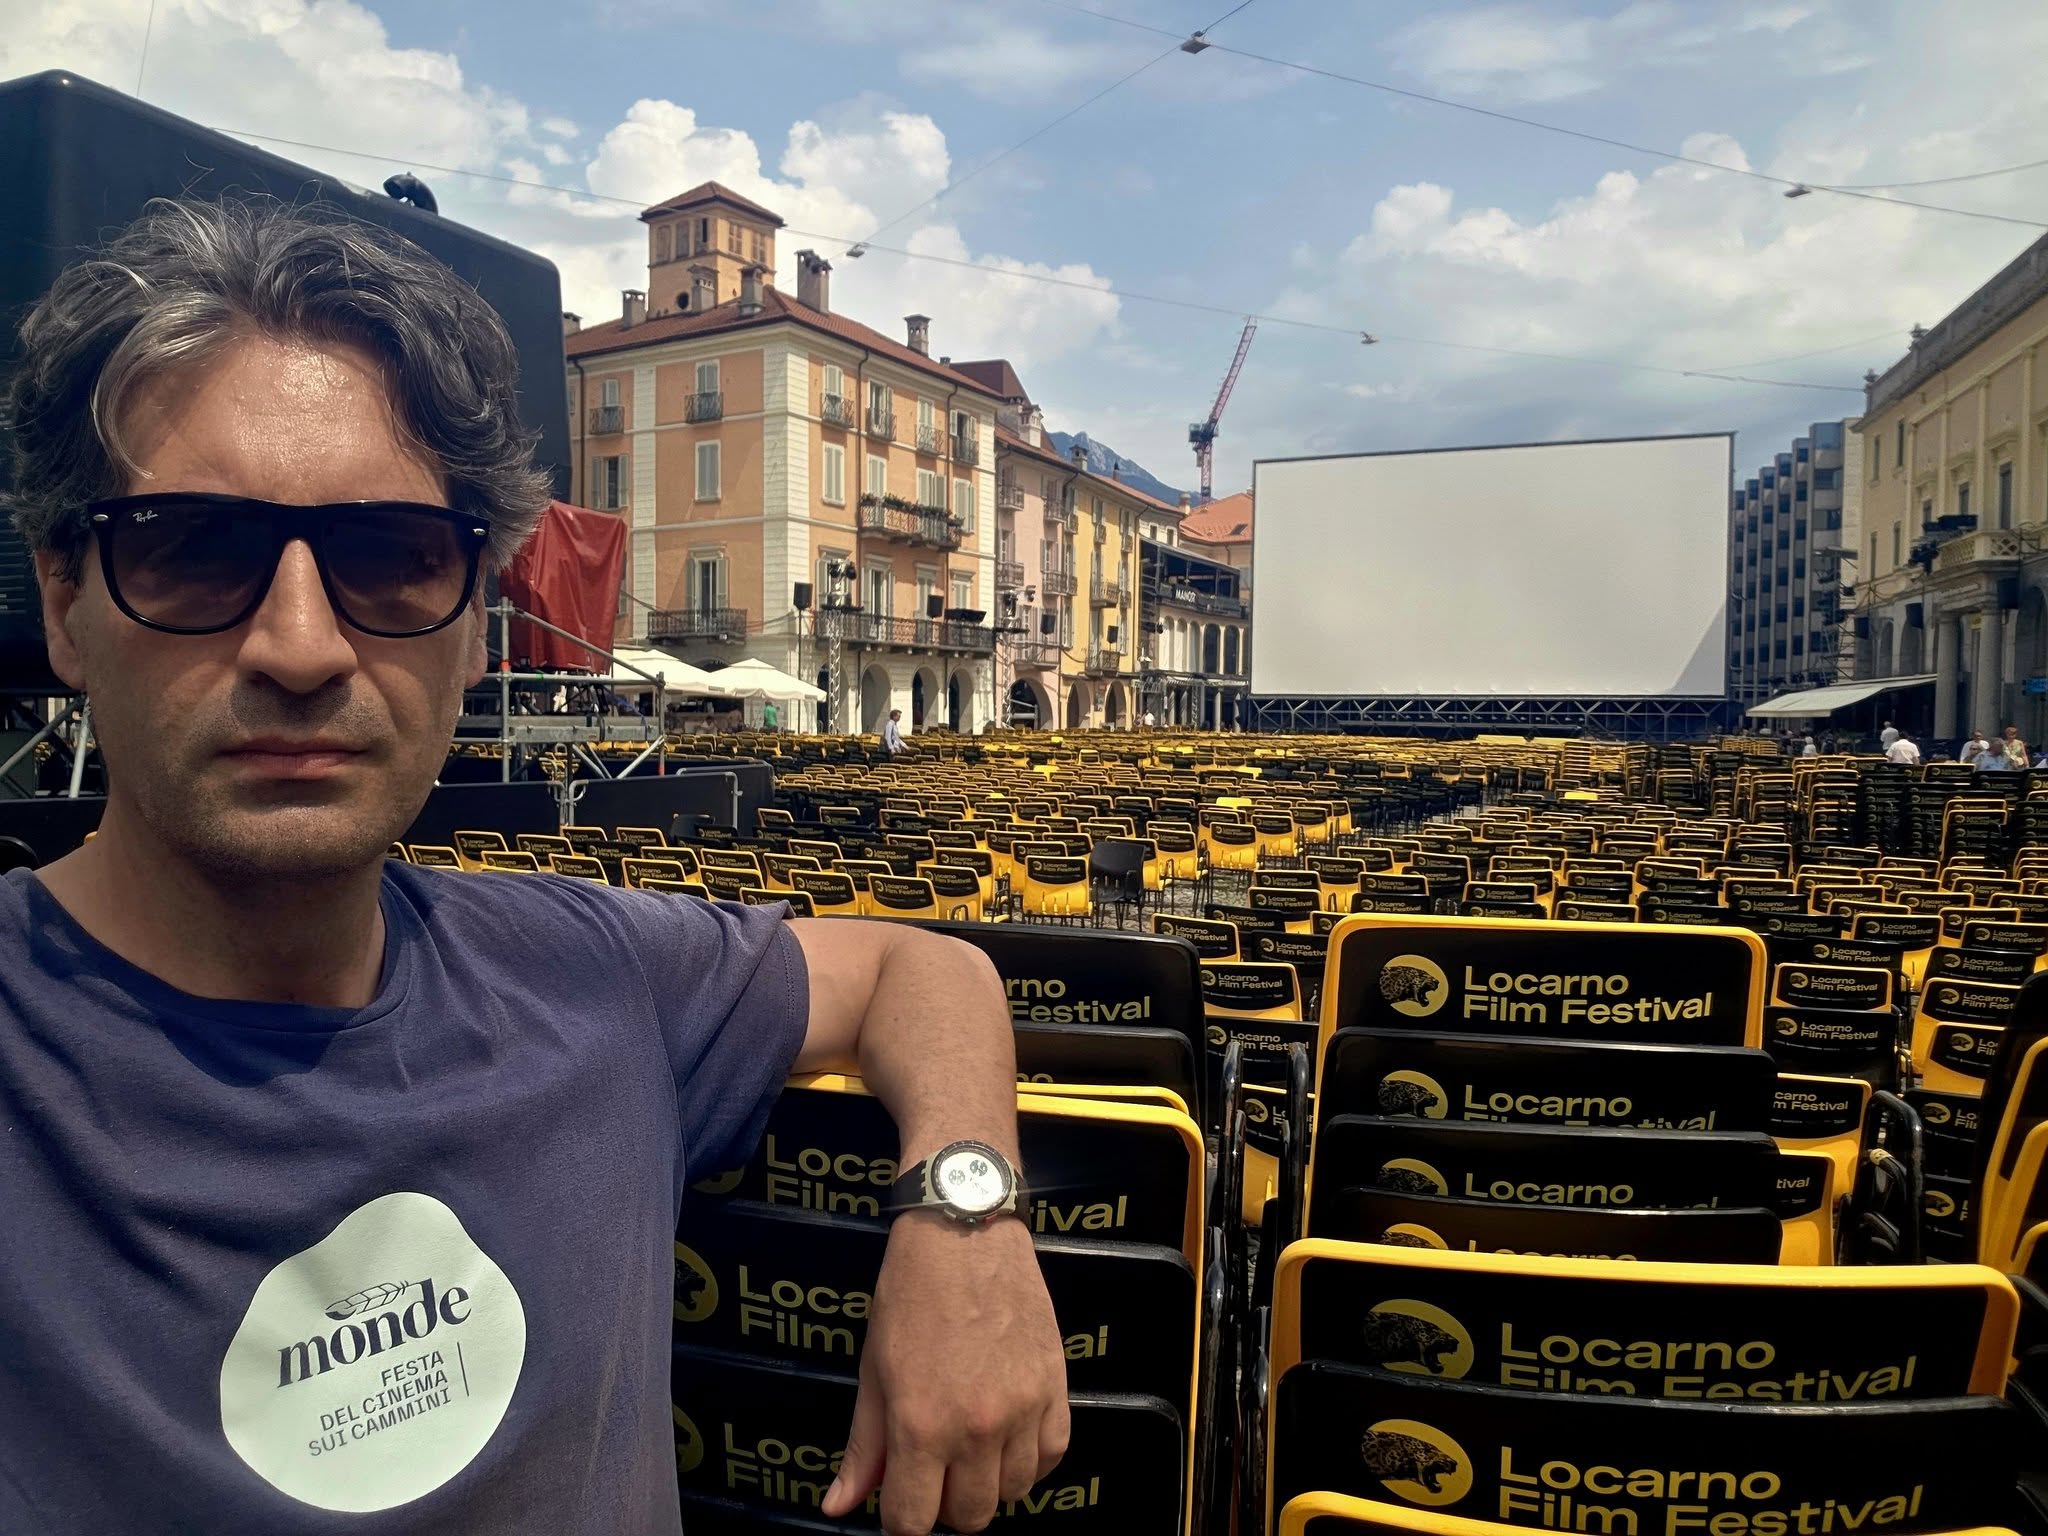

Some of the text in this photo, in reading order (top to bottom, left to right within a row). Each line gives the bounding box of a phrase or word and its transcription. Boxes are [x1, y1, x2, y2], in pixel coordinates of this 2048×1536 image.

[1176, 925, 1208, 934] Locarno
[1276, 941, 1311, 950] Locarno
[1833, 948, 1871, 956] Locarno
[1218, 973, 1259, 982] Locarno
[1218, 980, 1283, 988] Film Festival
[1464, 965, 1628, 995] Locarno
[1811, 976, 1855, 984] Locarno
[1811, 983, 1878, 991] Film Festival
[1006, 996, 1150, 1024] Festival
[1464, 992, 1712, 1024] Film Festival
[1962, 1000, 1986, 1008] Film
[1964, 992, 2009, 1002] Locarno
[1230, 1030, 1280, 1042] Locarno
[1801, 1030, 1878, 1040] Film Festival
[1802, 1022, 1852, 1032] Locarno
[1464, 1084, 1632, 1116] Locarno
[1775, 1092, 1817, 1102] carno
[1791, 1101, 1848, 1111] Festival
[767, 1134, 898, 1186] Loca
[1466, 1173, 1634, 1204] Locarno
[1777, 1177, 1810, 1189] tival
[767, 1173, 1127, 1232] Film ival
[739, 1265, 872, 1319] Loca
[277, 1278, 472, 1388] monde
[740, 1303, 854, 1356] Film
[1502, 1322, 1775, 1370] Locarno
[381, 1351, 444, 1387] FESTA
[320, 1370, 448, 1431] DEL CINEMA
[309, 1387, 451, 1456] SUI CAMMINI
[1501, 1446, 1780, 1499] Locarno
[1500, 1484, 1923, 1536] Film Festival
